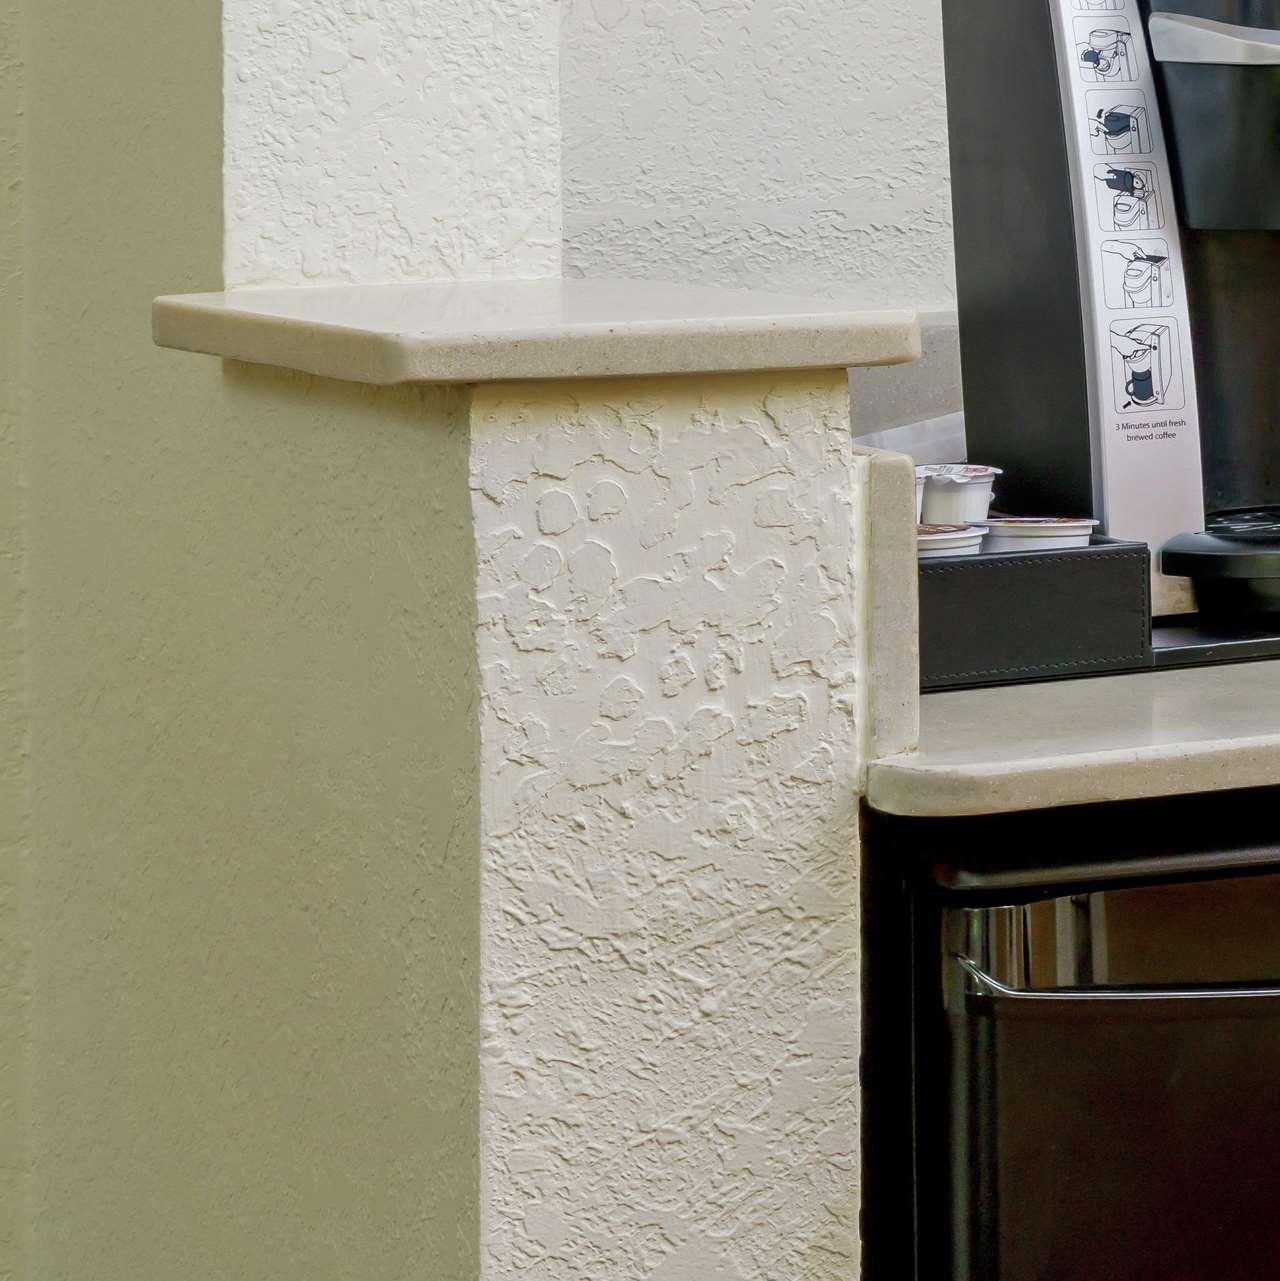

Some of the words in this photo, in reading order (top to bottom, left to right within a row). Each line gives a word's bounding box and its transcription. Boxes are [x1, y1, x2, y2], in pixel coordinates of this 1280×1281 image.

[1115, 423, 1120, 431] 3
[1121, 422, 1150, 430] Minutes
[1151, 420, 1167, 428] until
[1168, 419, 1186, 427] fresh
[1126, 433, 1153, 441] brewed
[1154, 431, 1176, 440] coffee
